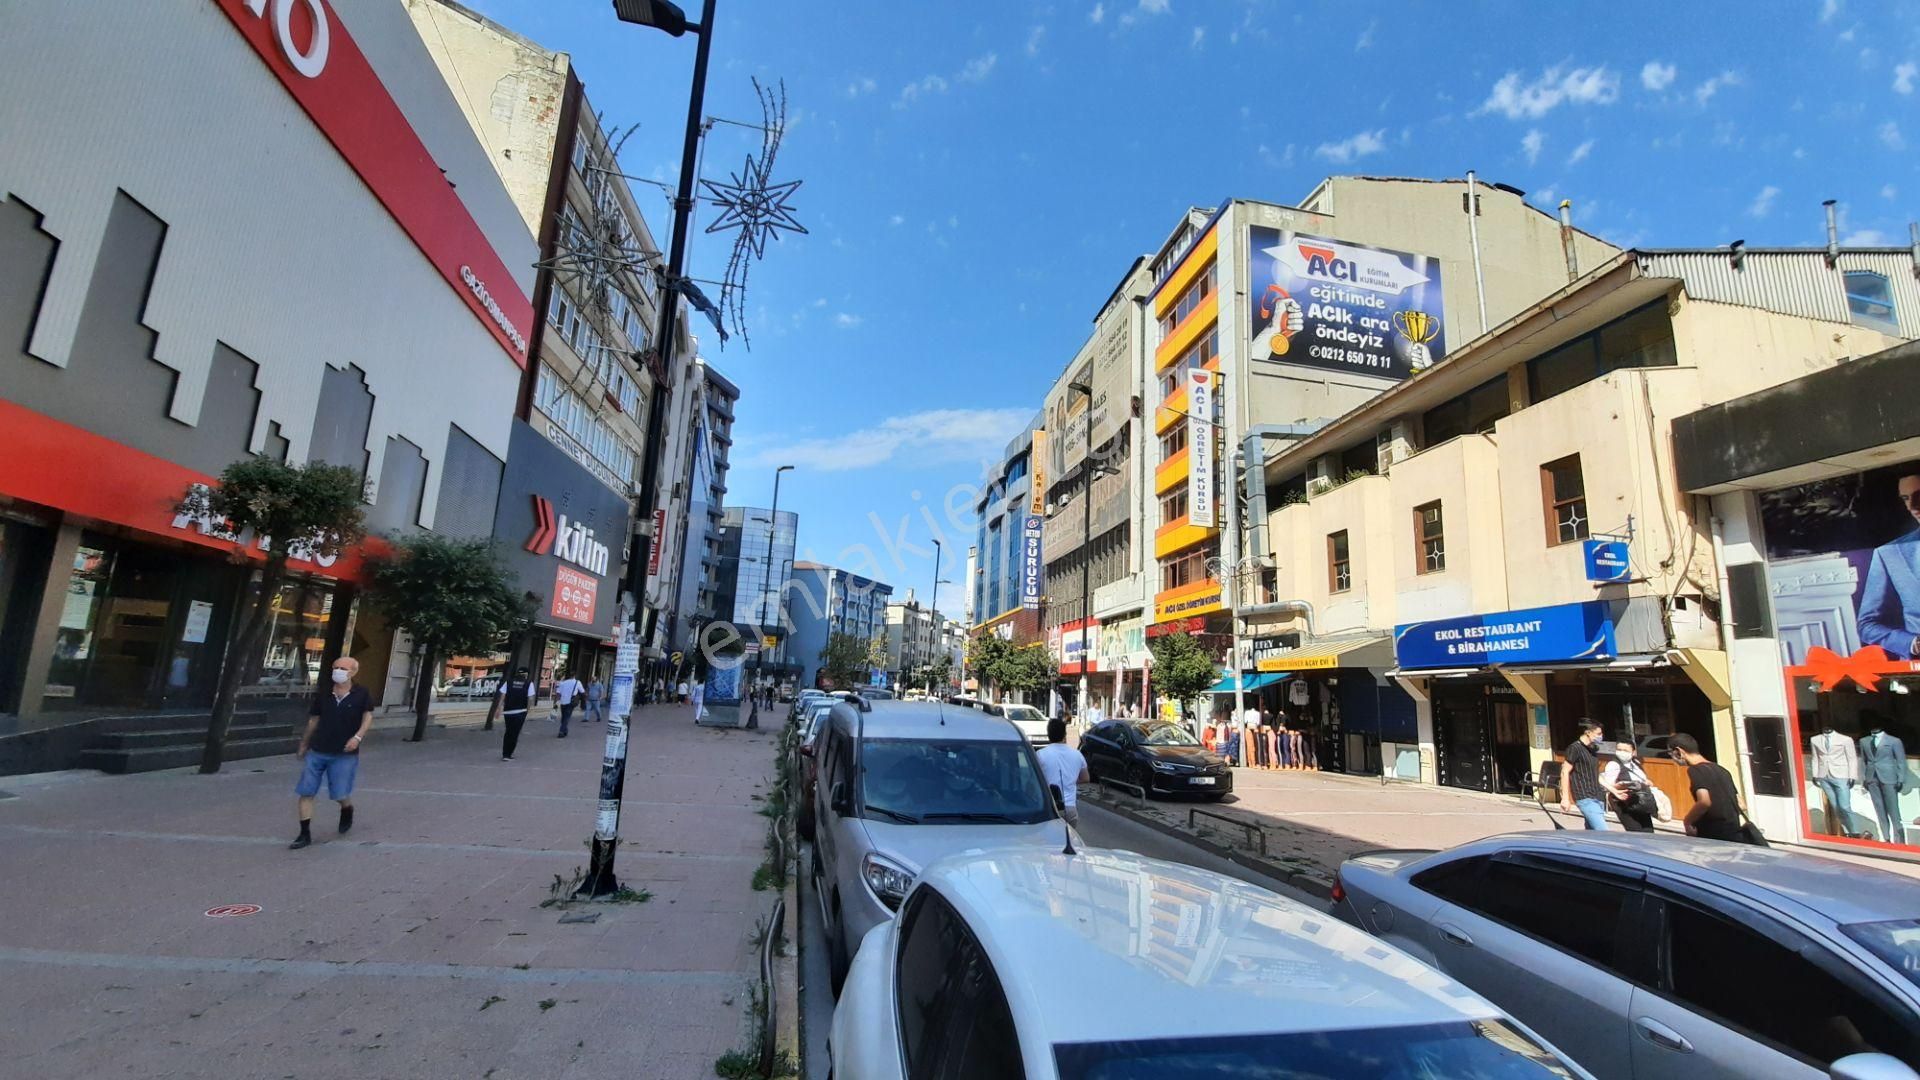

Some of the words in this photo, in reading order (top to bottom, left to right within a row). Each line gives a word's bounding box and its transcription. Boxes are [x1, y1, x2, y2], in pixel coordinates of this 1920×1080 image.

[1307, 254, 1358, 282] AÇI
[1359, 277, 1399, 290] KURUMLARI
[1310, 284, 1386, 309] eğitimde
[460, 265, 526, 354] GAZİOSMANPAŞA
[1315, 324, 1384, 348] öndeyiz
[1360, 316, 1390, 332] ara
[1320, 345, 1345, 361] 0212
[1346, 350, 1363, 364] 650
[1366, 353, 1378, 367] 78
[1380, 356, 1391, 369] 11
[548, 425, 584, 463] CENNET
[1197, 477, 1205, 511] KURSU
[554, 514, 609, 577] kilim
[1026, 538, 1037, 596] SÜRÜCÜ
[557, 602, 562, 614] 3
[573, 607, 578, 618] 2
[1435, 627, 1462, 641] EKOL
[1464, 620, 1542, 639] RESTAURANT
[1448, 644, 1456, 655] &
[1458, 636, 1529, 655] BİRAHANESİ
